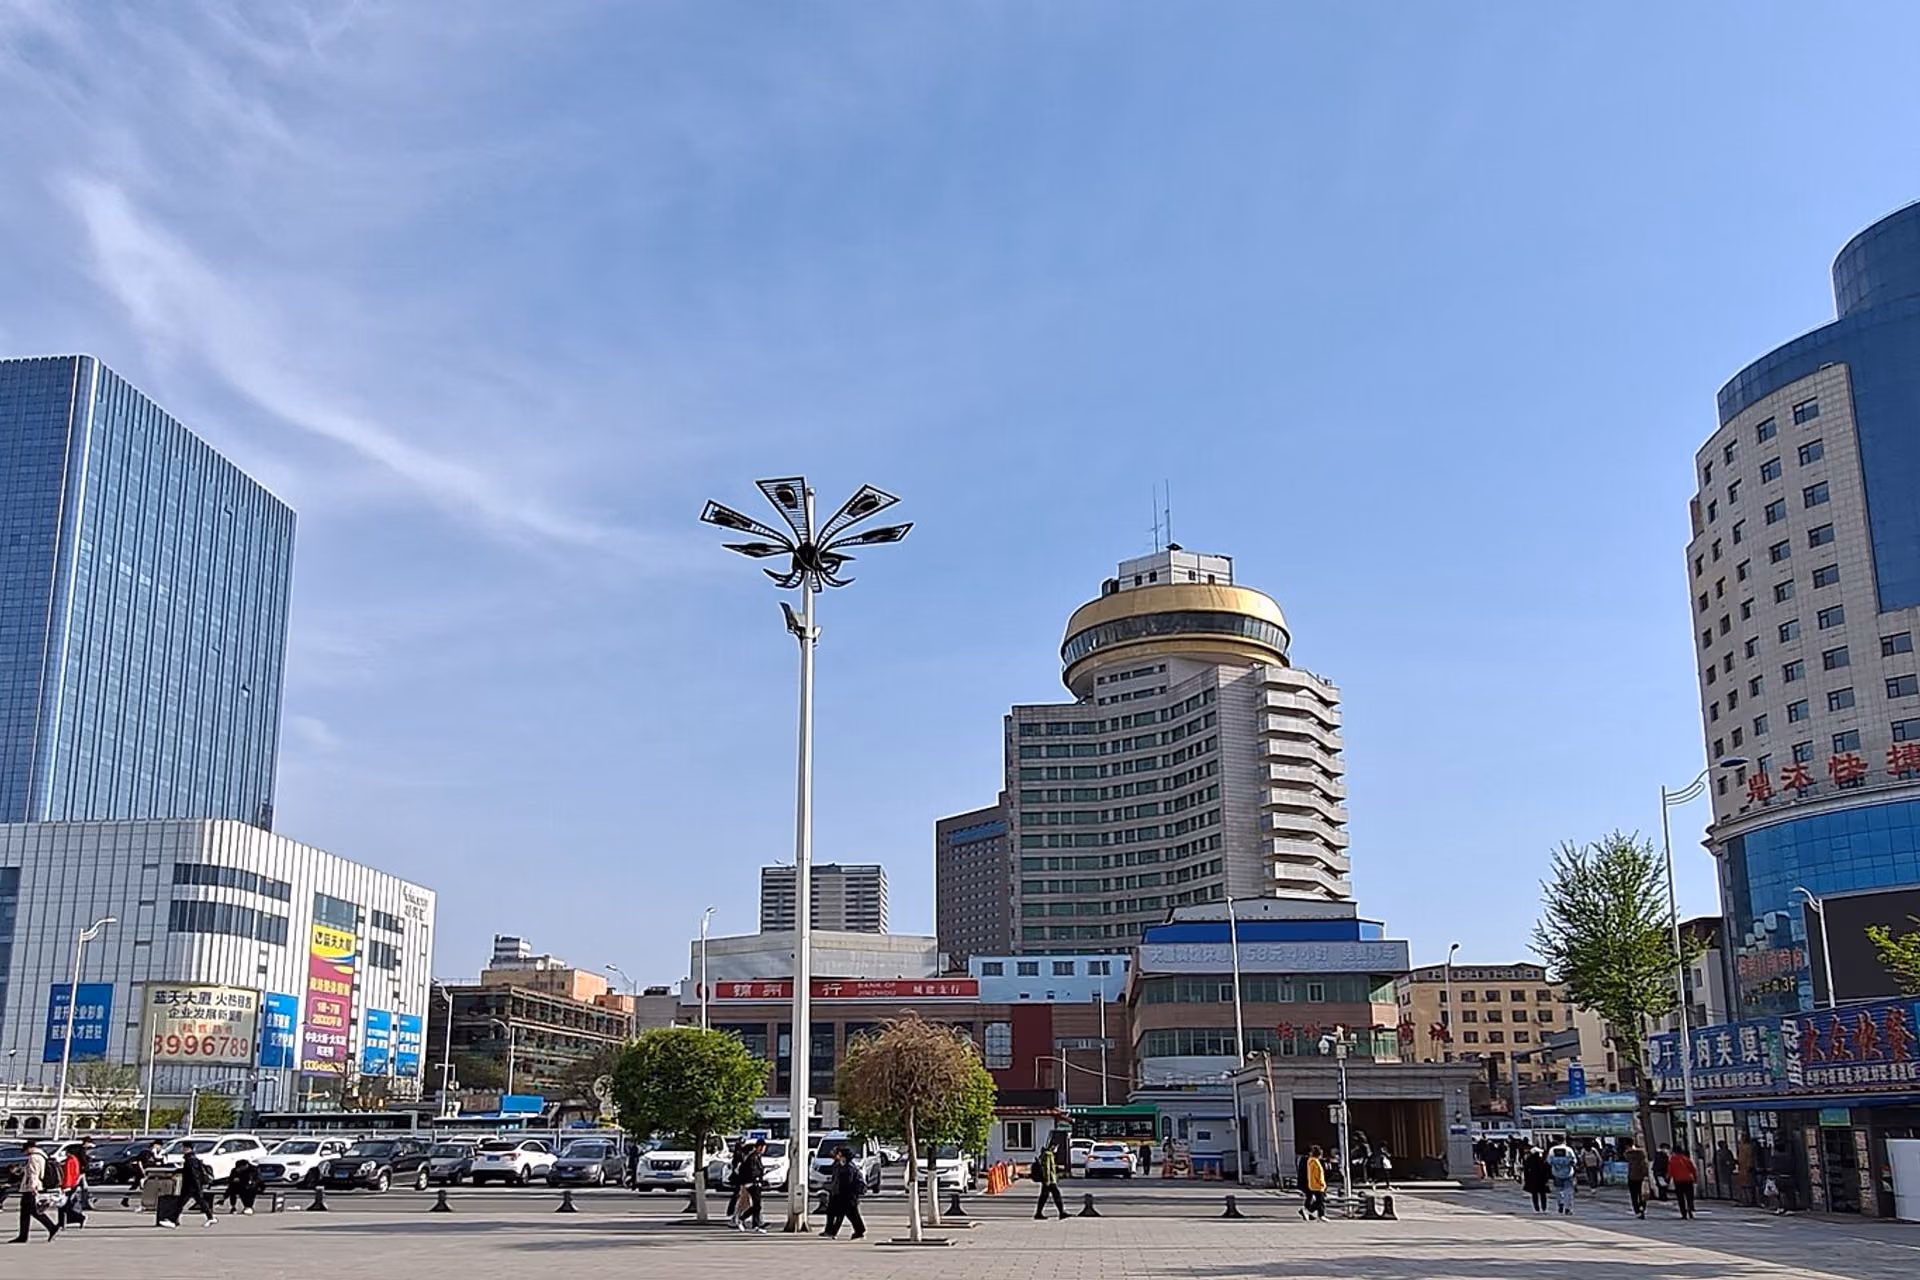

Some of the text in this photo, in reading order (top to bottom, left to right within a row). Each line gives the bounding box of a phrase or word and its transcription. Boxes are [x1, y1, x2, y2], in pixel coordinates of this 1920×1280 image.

[153, 990, 212, 1006] 蓝天大厦
[733, 983, 843, 998] 锦州行
[1661, 1026, 1759, 1069] 于肉夹馍
